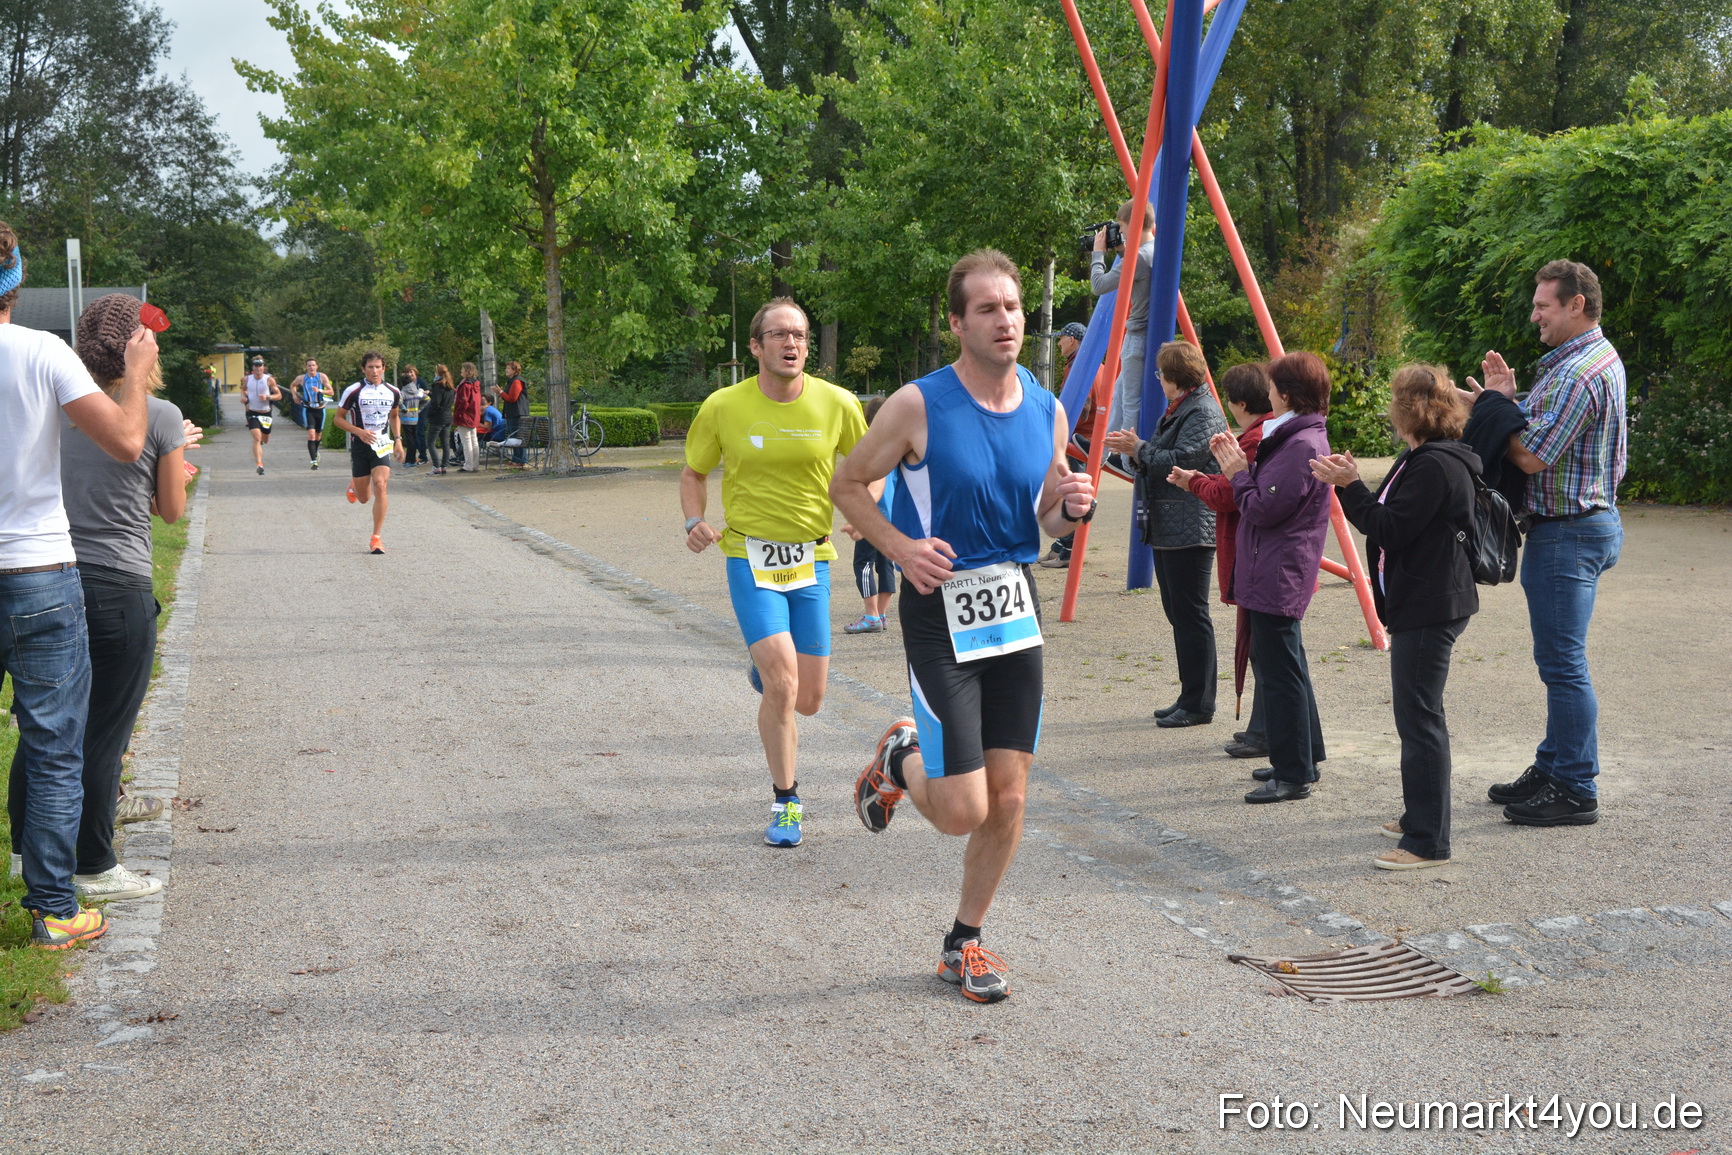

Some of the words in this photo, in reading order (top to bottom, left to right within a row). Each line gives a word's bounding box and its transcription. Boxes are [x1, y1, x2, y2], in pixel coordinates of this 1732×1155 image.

[762, 543, 804, 567] 203
[943, 578, 977, 591] PARTL
[955, 581, 1025, 625] 3324
[969, 634, 1002, 649] Martin
